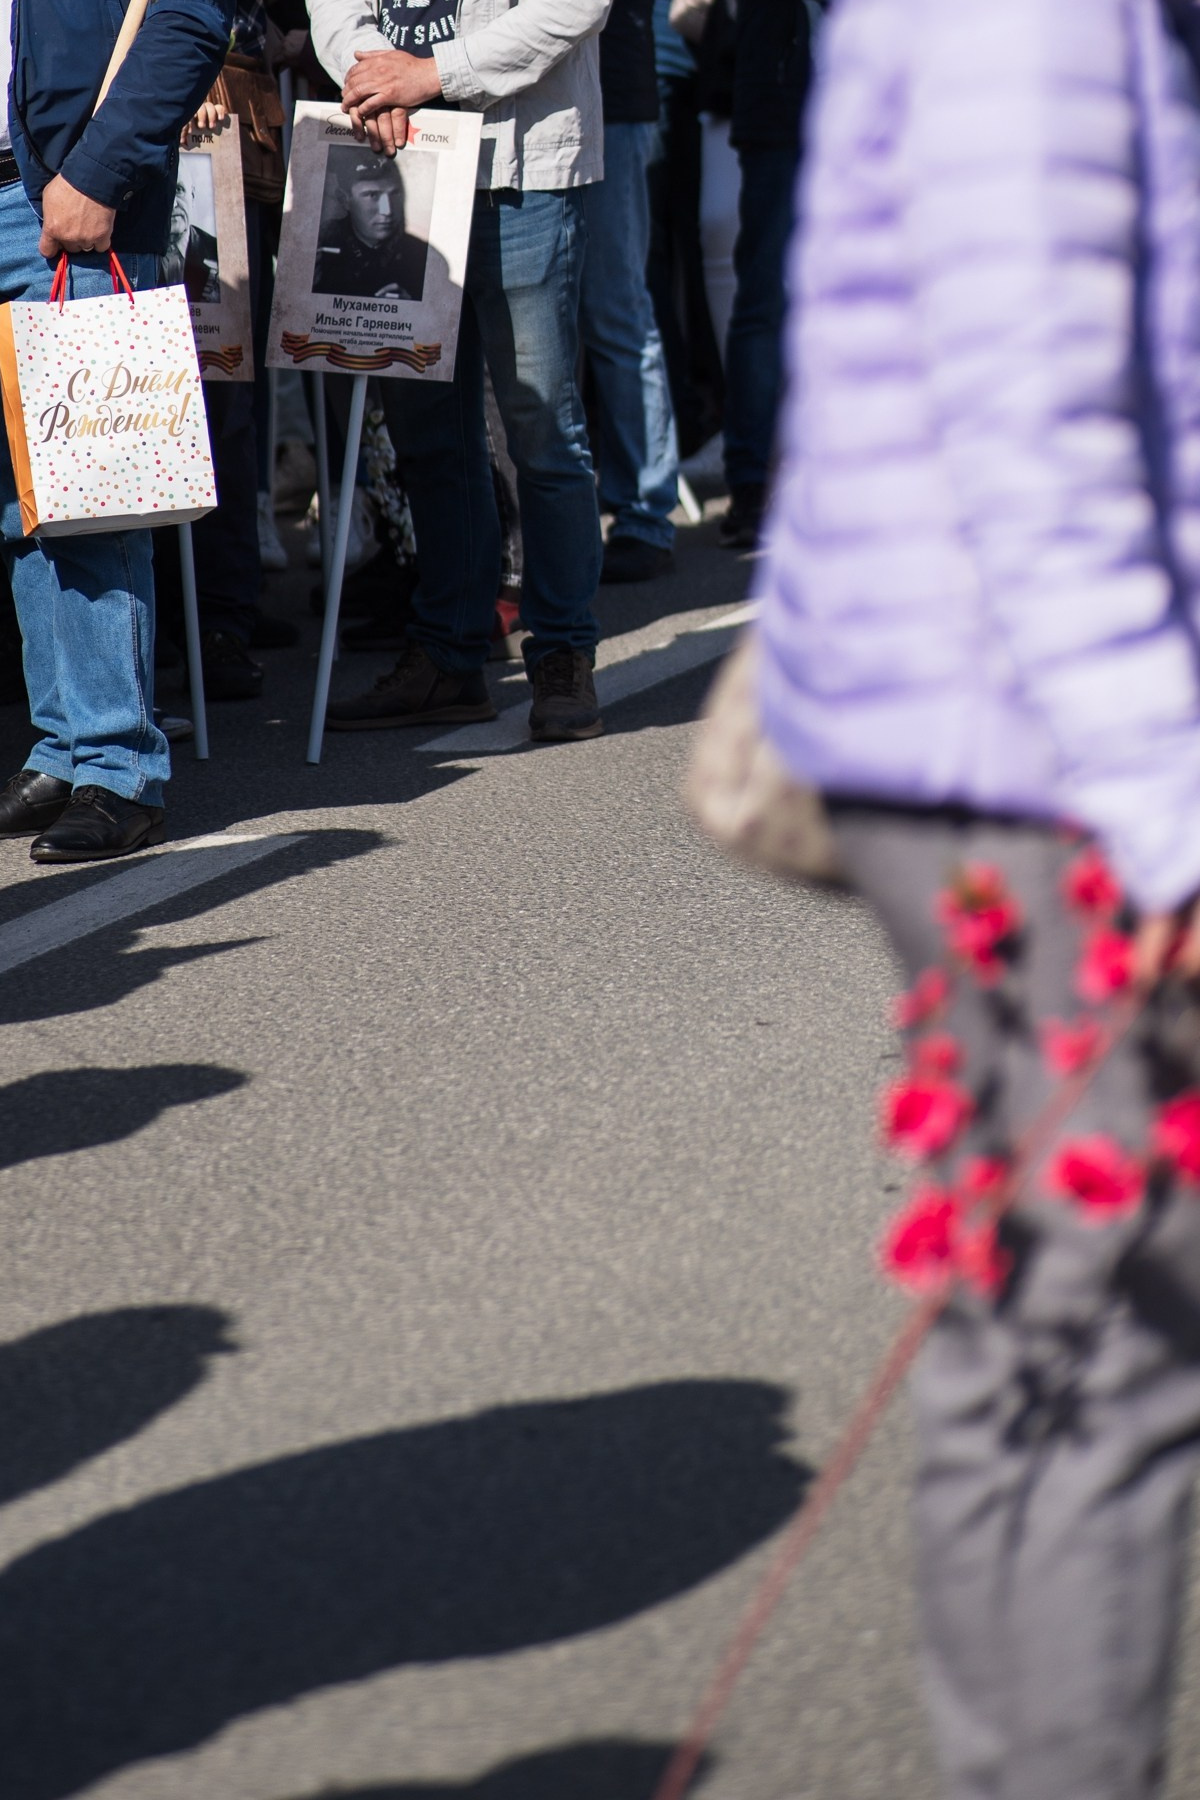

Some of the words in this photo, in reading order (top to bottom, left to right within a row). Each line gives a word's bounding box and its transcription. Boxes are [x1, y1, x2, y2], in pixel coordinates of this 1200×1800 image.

[191, 134, 214, 144] полк
[420, 132, 450, 144] полк
[333, 297, 398, 313] Мухаметов
[315, 313, 352, 327] Ильяс
[355, 316, 412, 331] Гаряевич
[311, 327, 341, 336] Помощник
[343, 330, 378, 339] начальника
[378, 332, 415, 342] артиллерии
[339, 337, 358, 345] штаба
[358, 339, 384, 347] дивизии
[39, 392, 192, 443] Рождения!
